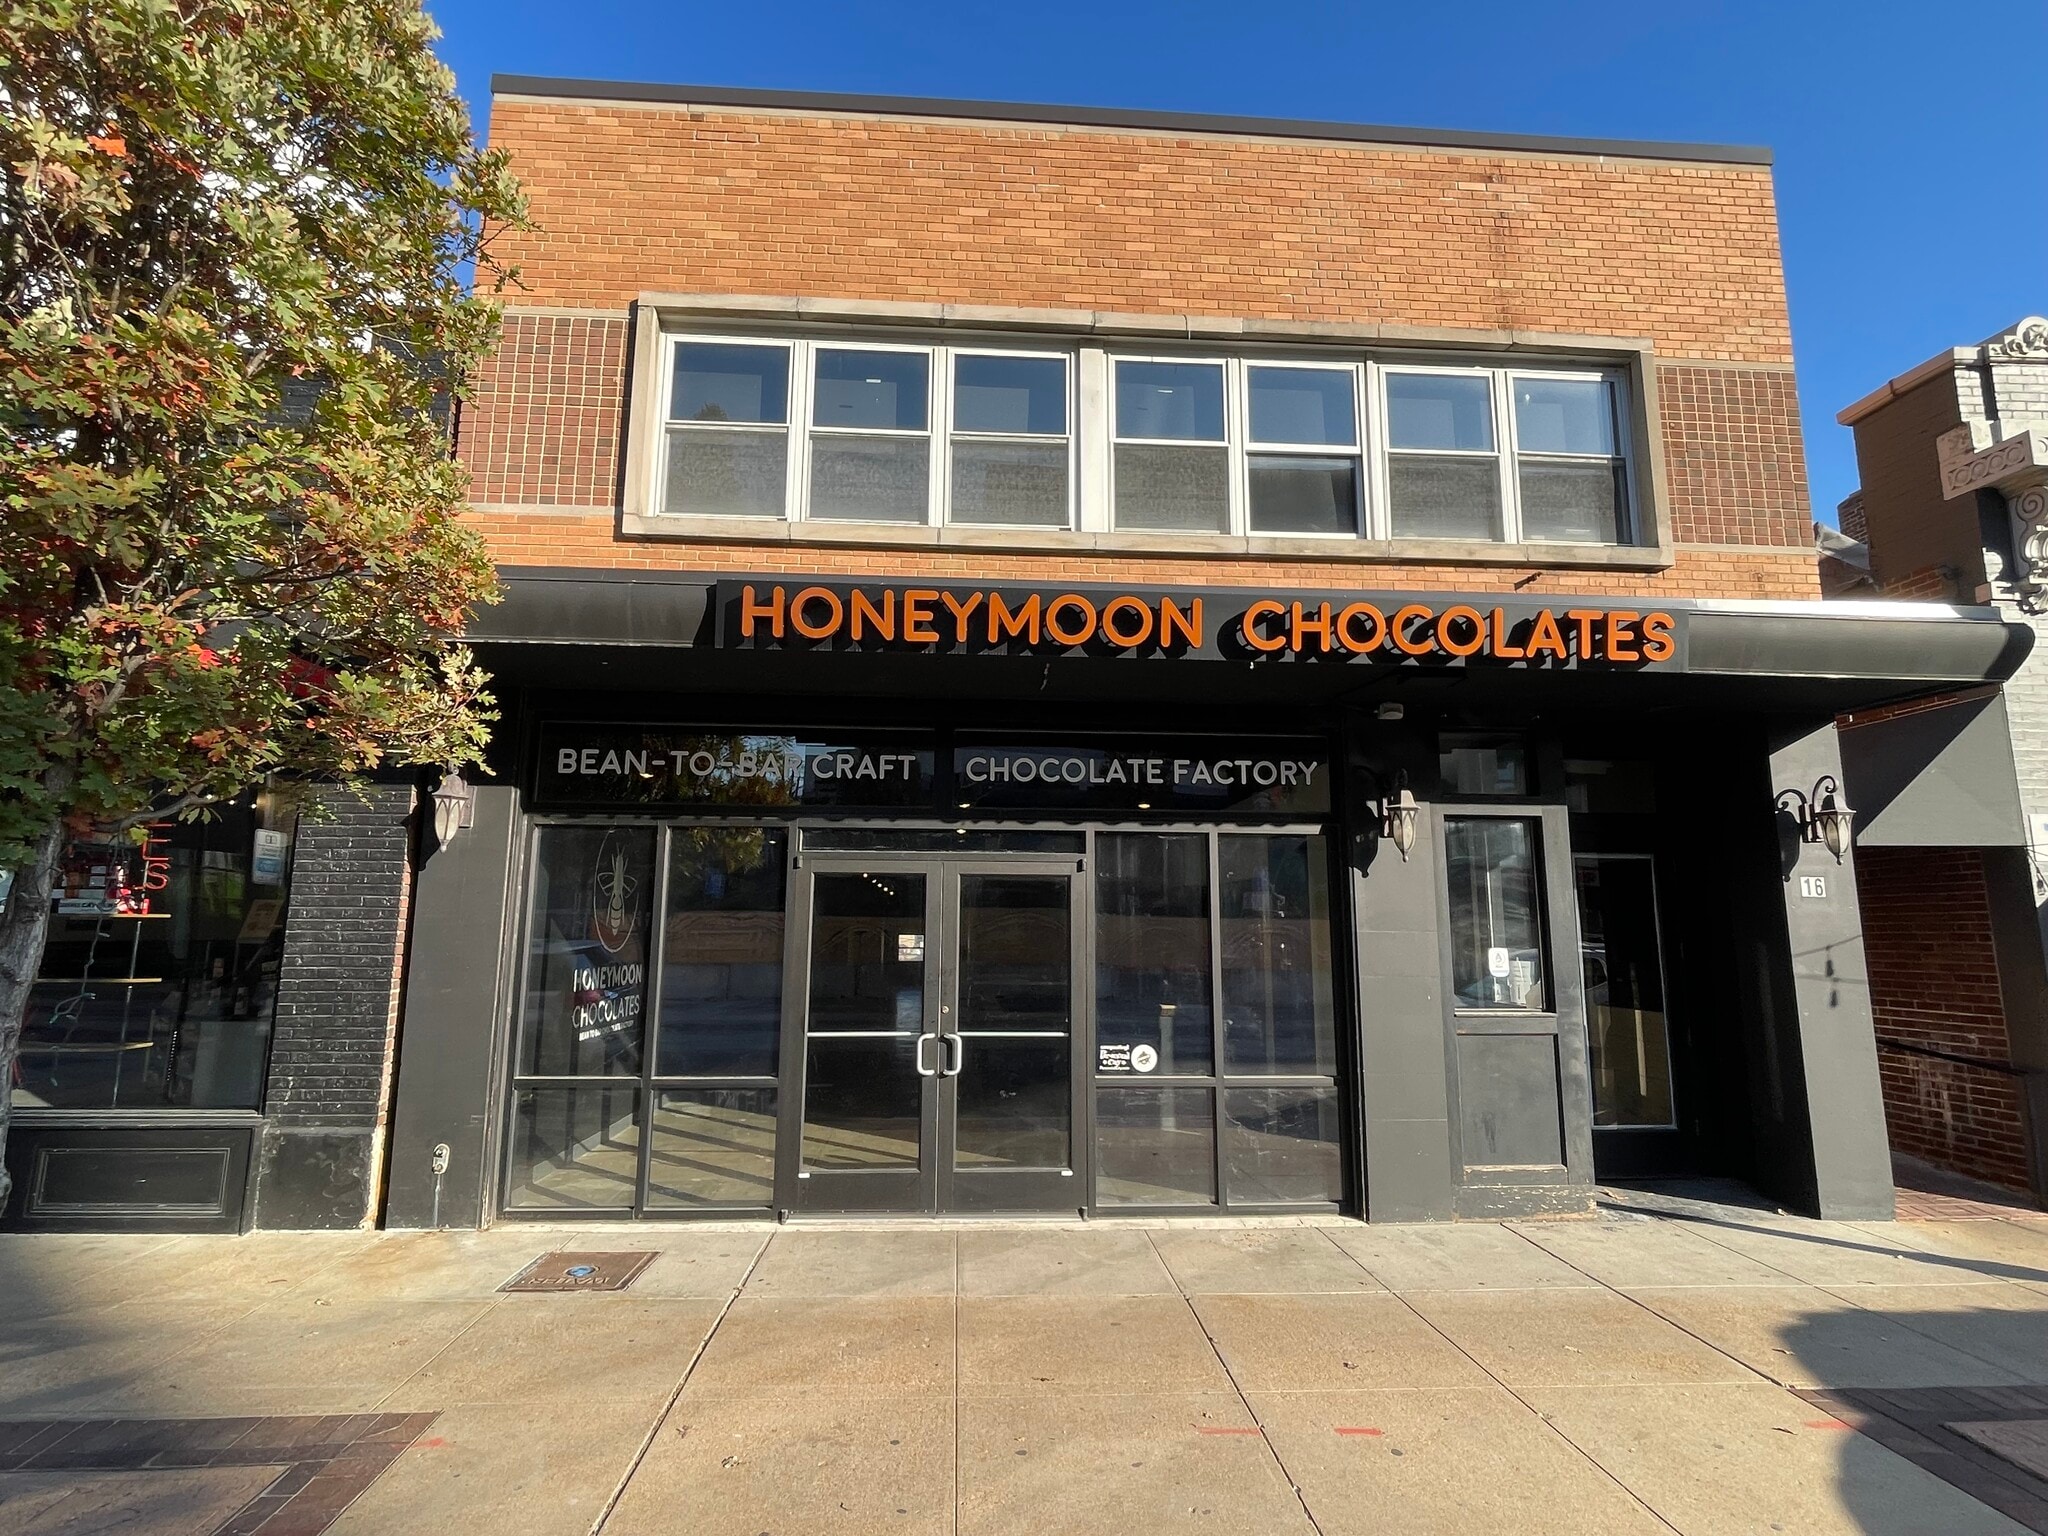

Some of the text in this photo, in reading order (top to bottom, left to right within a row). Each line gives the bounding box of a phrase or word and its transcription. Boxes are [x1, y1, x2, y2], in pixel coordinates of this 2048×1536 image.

[741, 584, 1677, 662] HONEYMOON CHOCOLATES
[557, 748, 917, 780] BEAN-TO-BAR CRAFT
[966, 756, 1318, 786] CHOCOLATE FACTORY
[1804, 878, 1824, 896] 16
[573, 964, 642, 992] HONEYMOON
[572, 995, 640, 1029] CHOCOLATES
